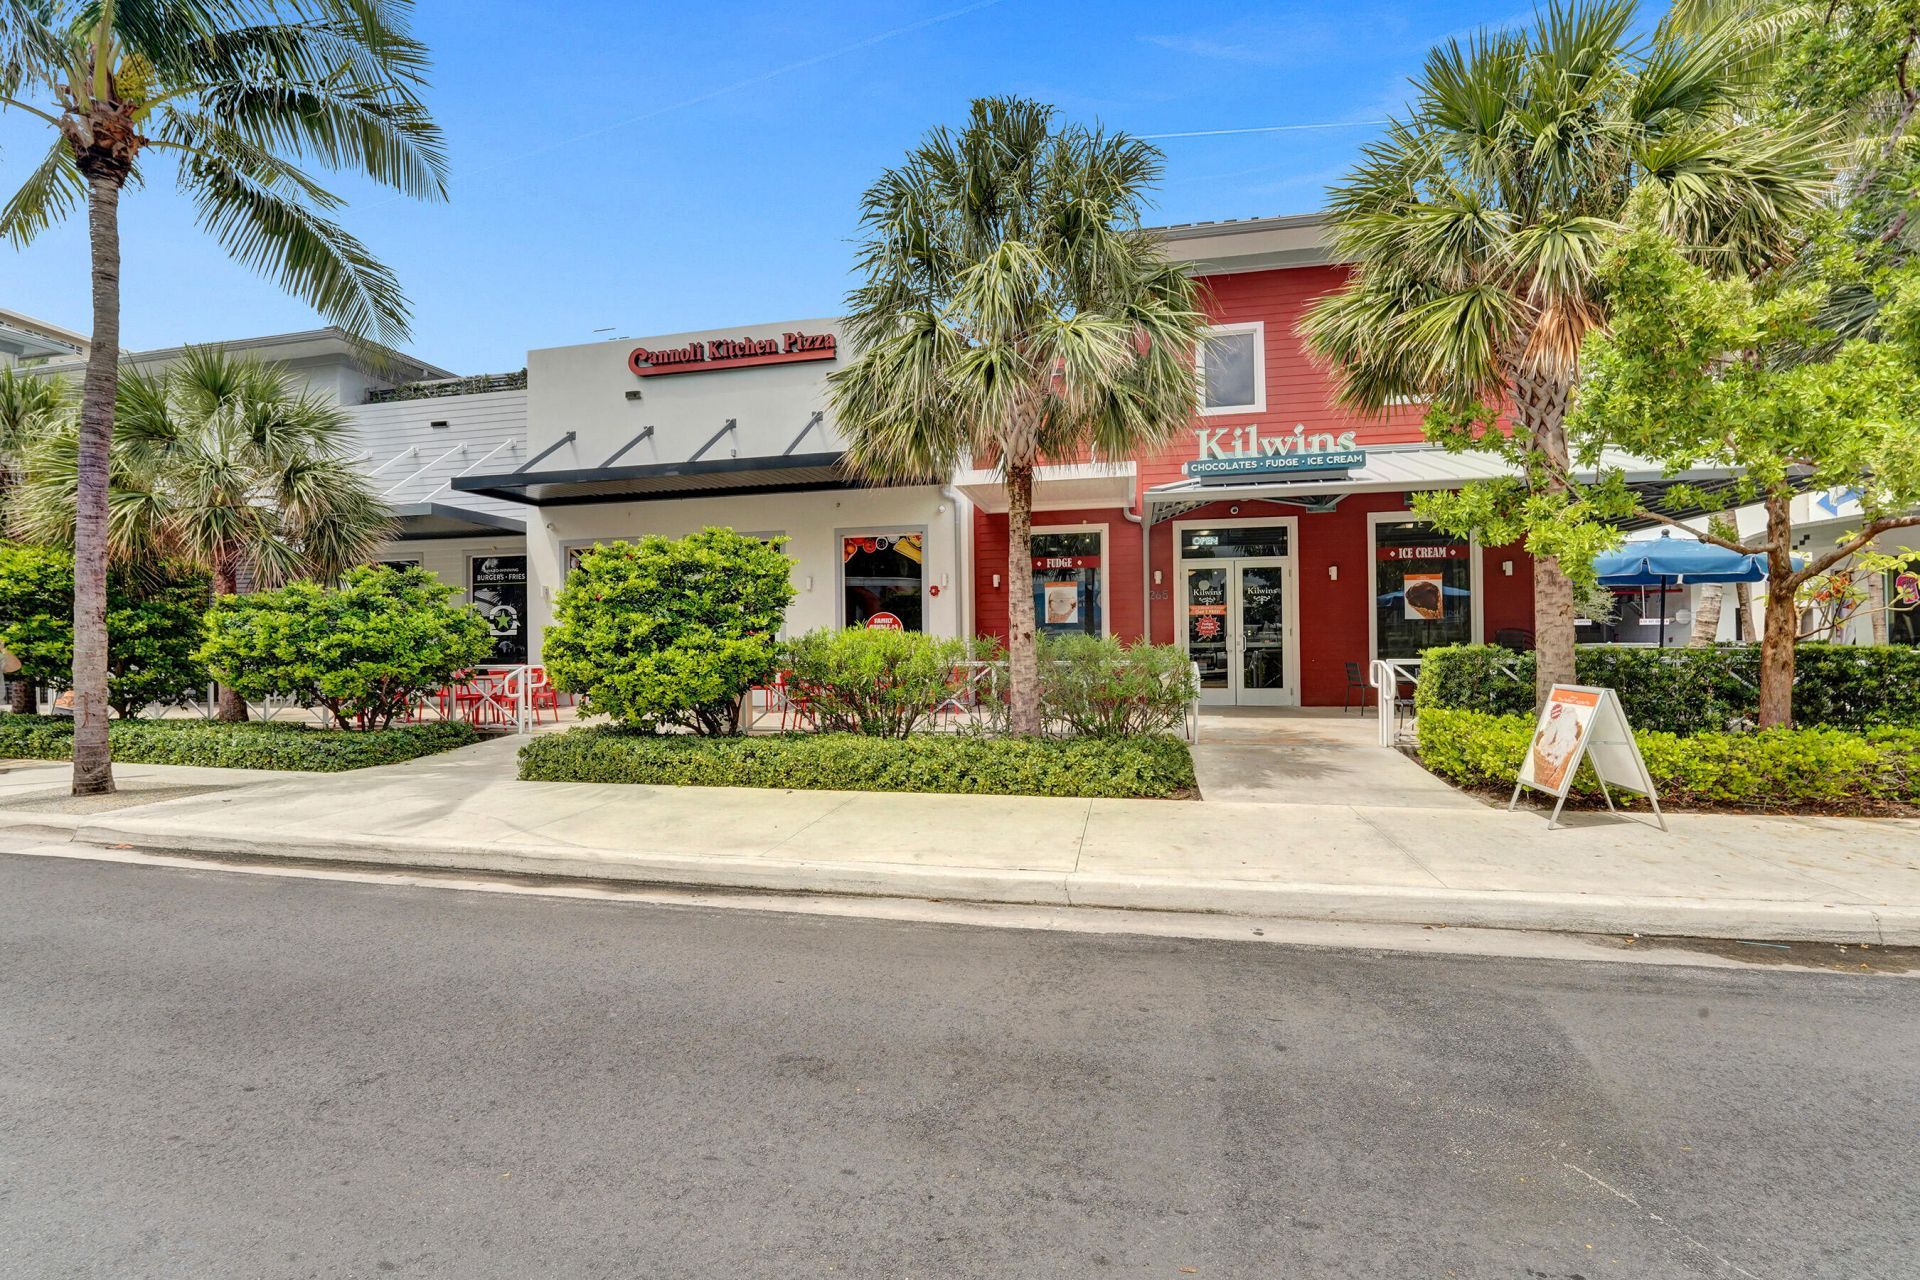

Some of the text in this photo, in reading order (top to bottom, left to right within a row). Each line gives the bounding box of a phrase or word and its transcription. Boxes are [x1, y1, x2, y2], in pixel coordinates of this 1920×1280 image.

[628, 331, 837, 377] Cannoli Kitchen Pizza
[1194, 423, 1357, 461] Kilwins
[1190, 454, 1364, 473] CHOCOLATES FUDGE ICE CREAM
[1192, 536, 1218, 545] OPEN
[1398, 546, 1447, 559] ICE CREAM
[1046, 557, 1073, 568] FUDGE
[1193, 588, 1222, 596] Kilwins
[1247, 586, 1279, 595] Kilwins
